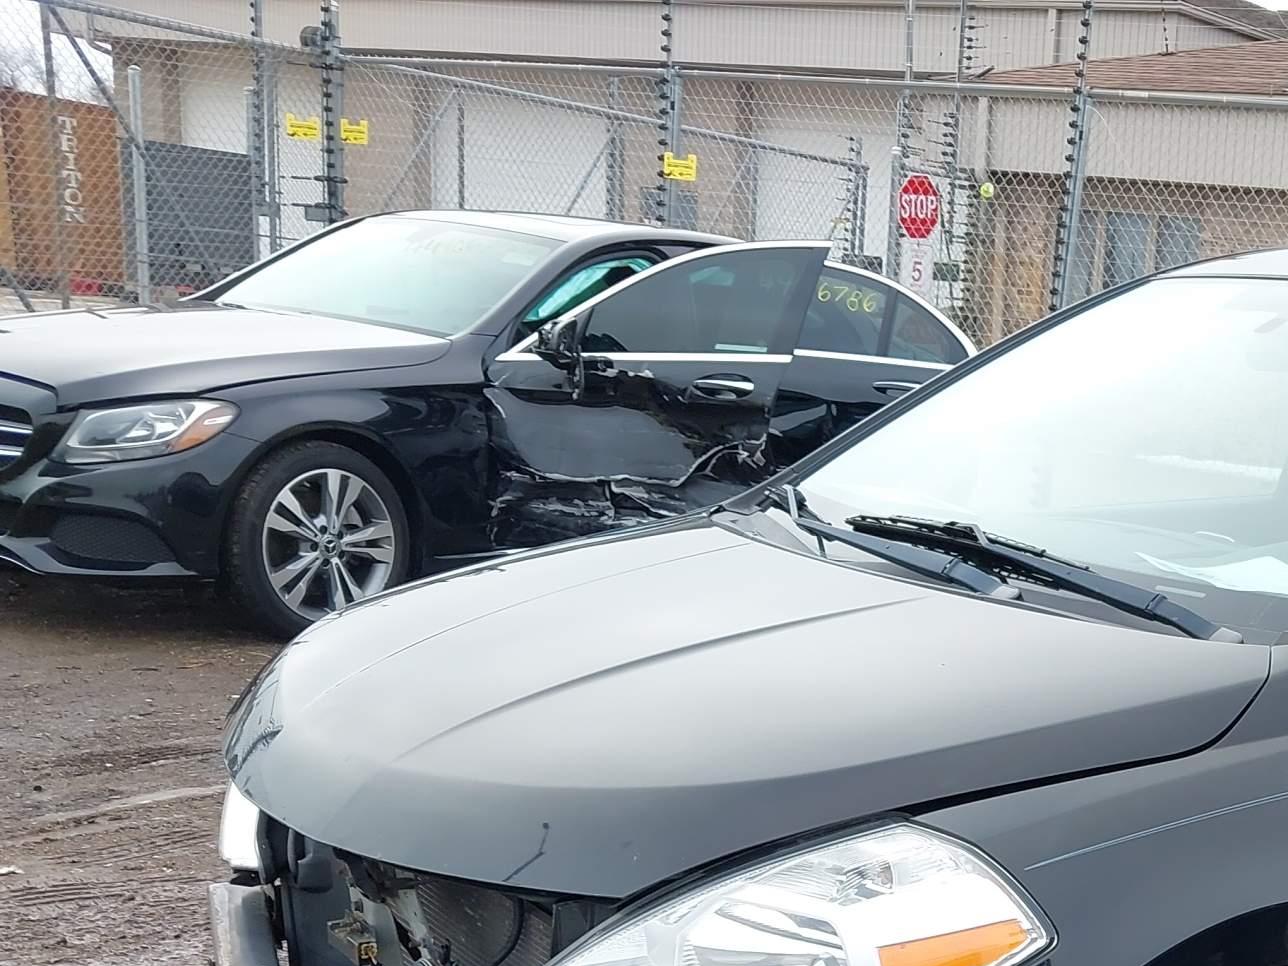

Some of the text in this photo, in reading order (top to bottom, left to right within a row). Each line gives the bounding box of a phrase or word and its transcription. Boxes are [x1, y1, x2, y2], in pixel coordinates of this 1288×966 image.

[58, 115, 84, 224] TRITON
[901, 195, 937, 218] STOP
[912, 261, 922, 281] 5
[818, 282, 877, 312] 6786
